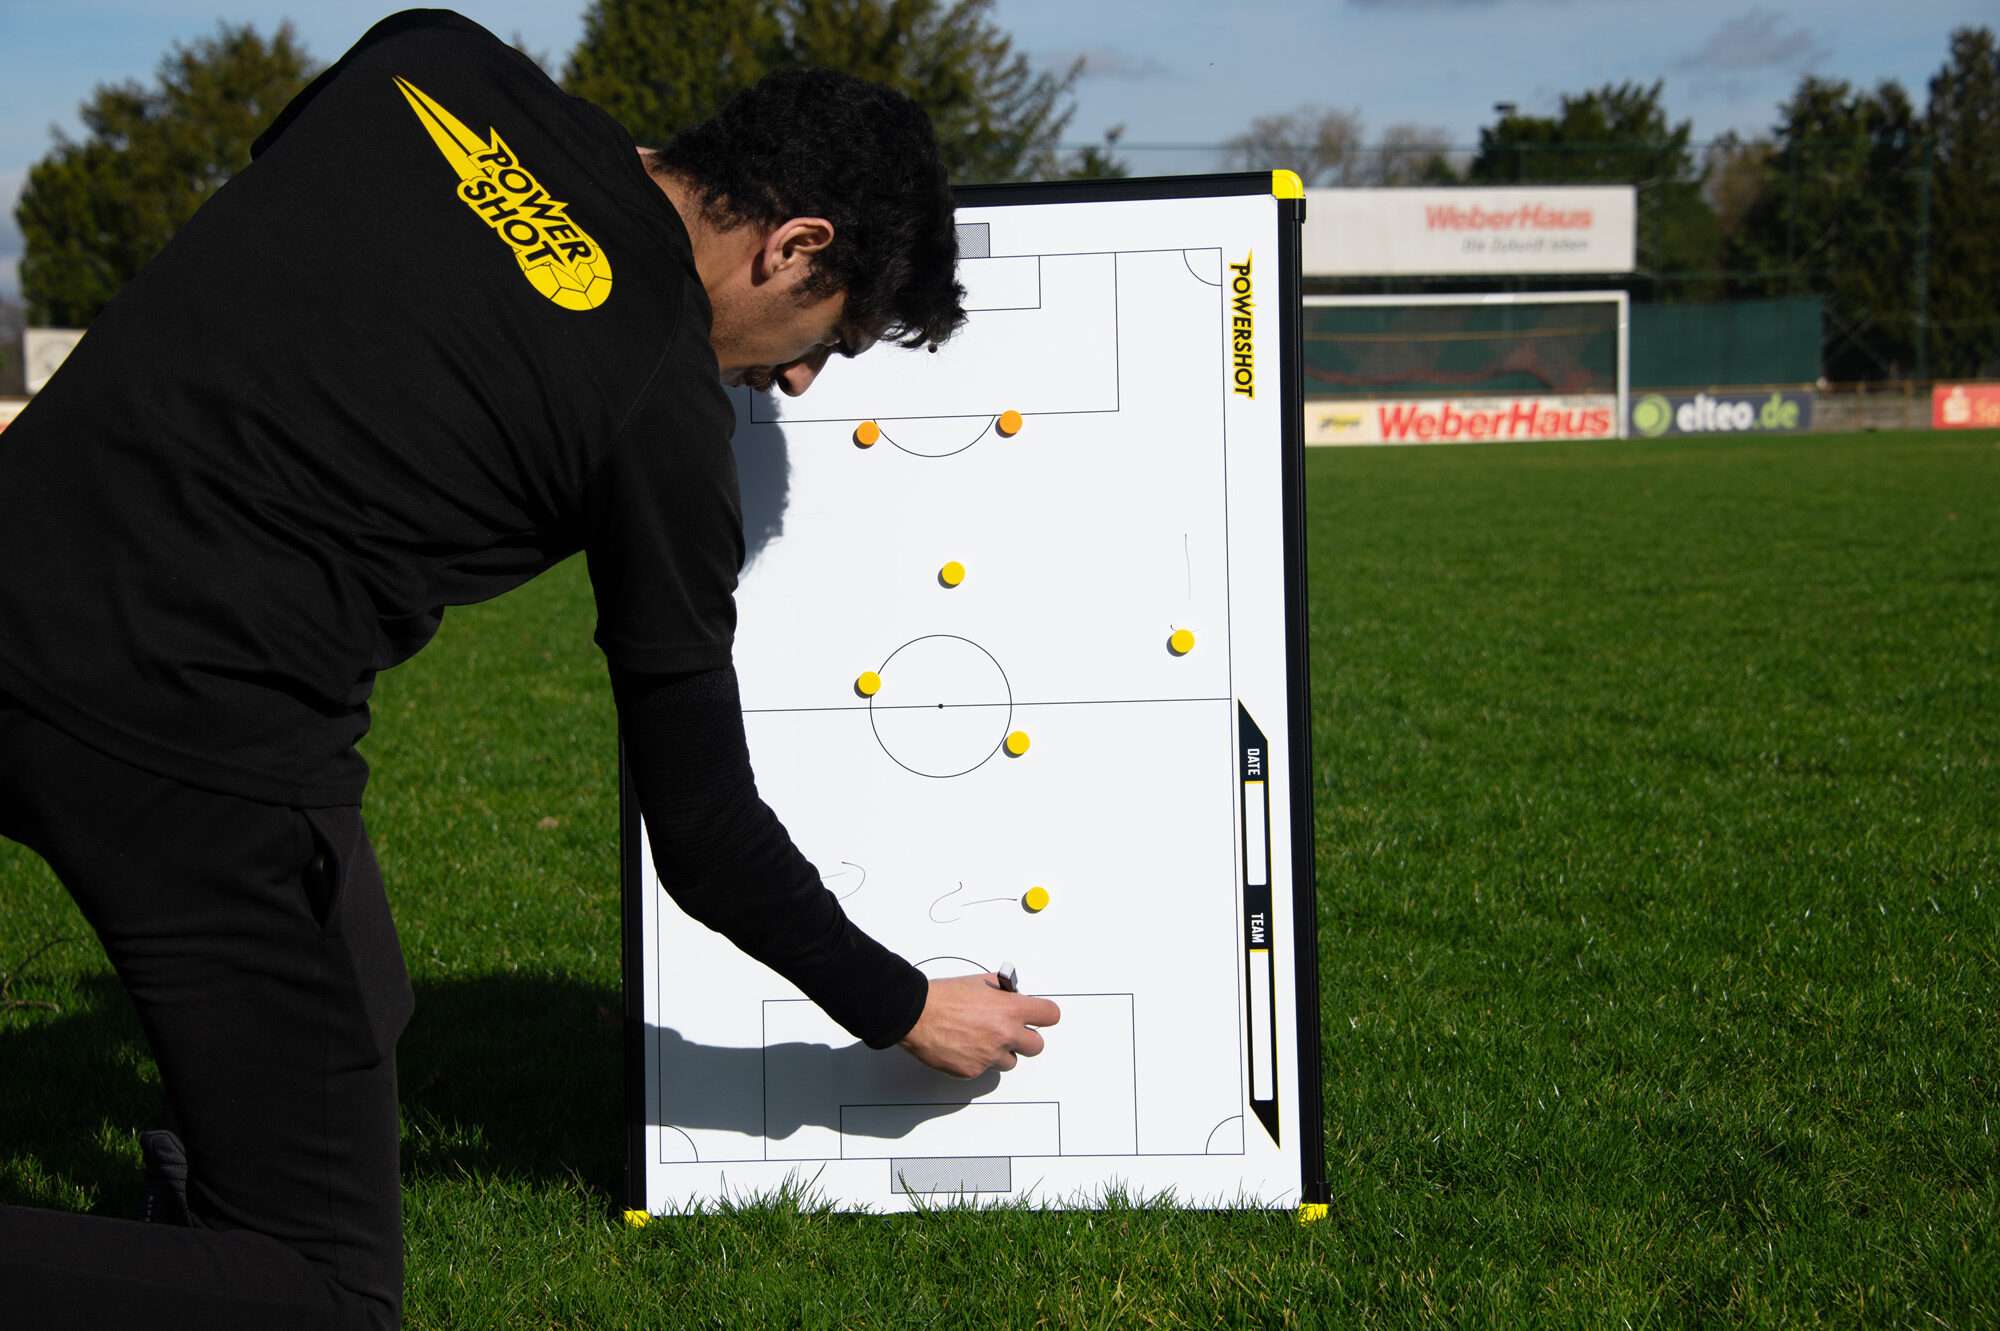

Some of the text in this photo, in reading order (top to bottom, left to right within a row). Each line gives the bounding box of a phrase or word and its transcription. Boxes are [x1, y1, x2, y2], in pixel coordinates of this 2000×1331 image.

[477, 140, 593, 264] POWER
[1425, 202, 1594, 231] WeberHaus
[463, 180, 568, 267] SHOT
[1230, 256, 1254, 399] POWERSHOT
[1377, 400, 1612, 441] WeberHaus
[1676, 391, 1799, 432] elteo.de
[1247, 748, 1261, 776] DATE
[1251, 912, 1265, 943] TEAM
